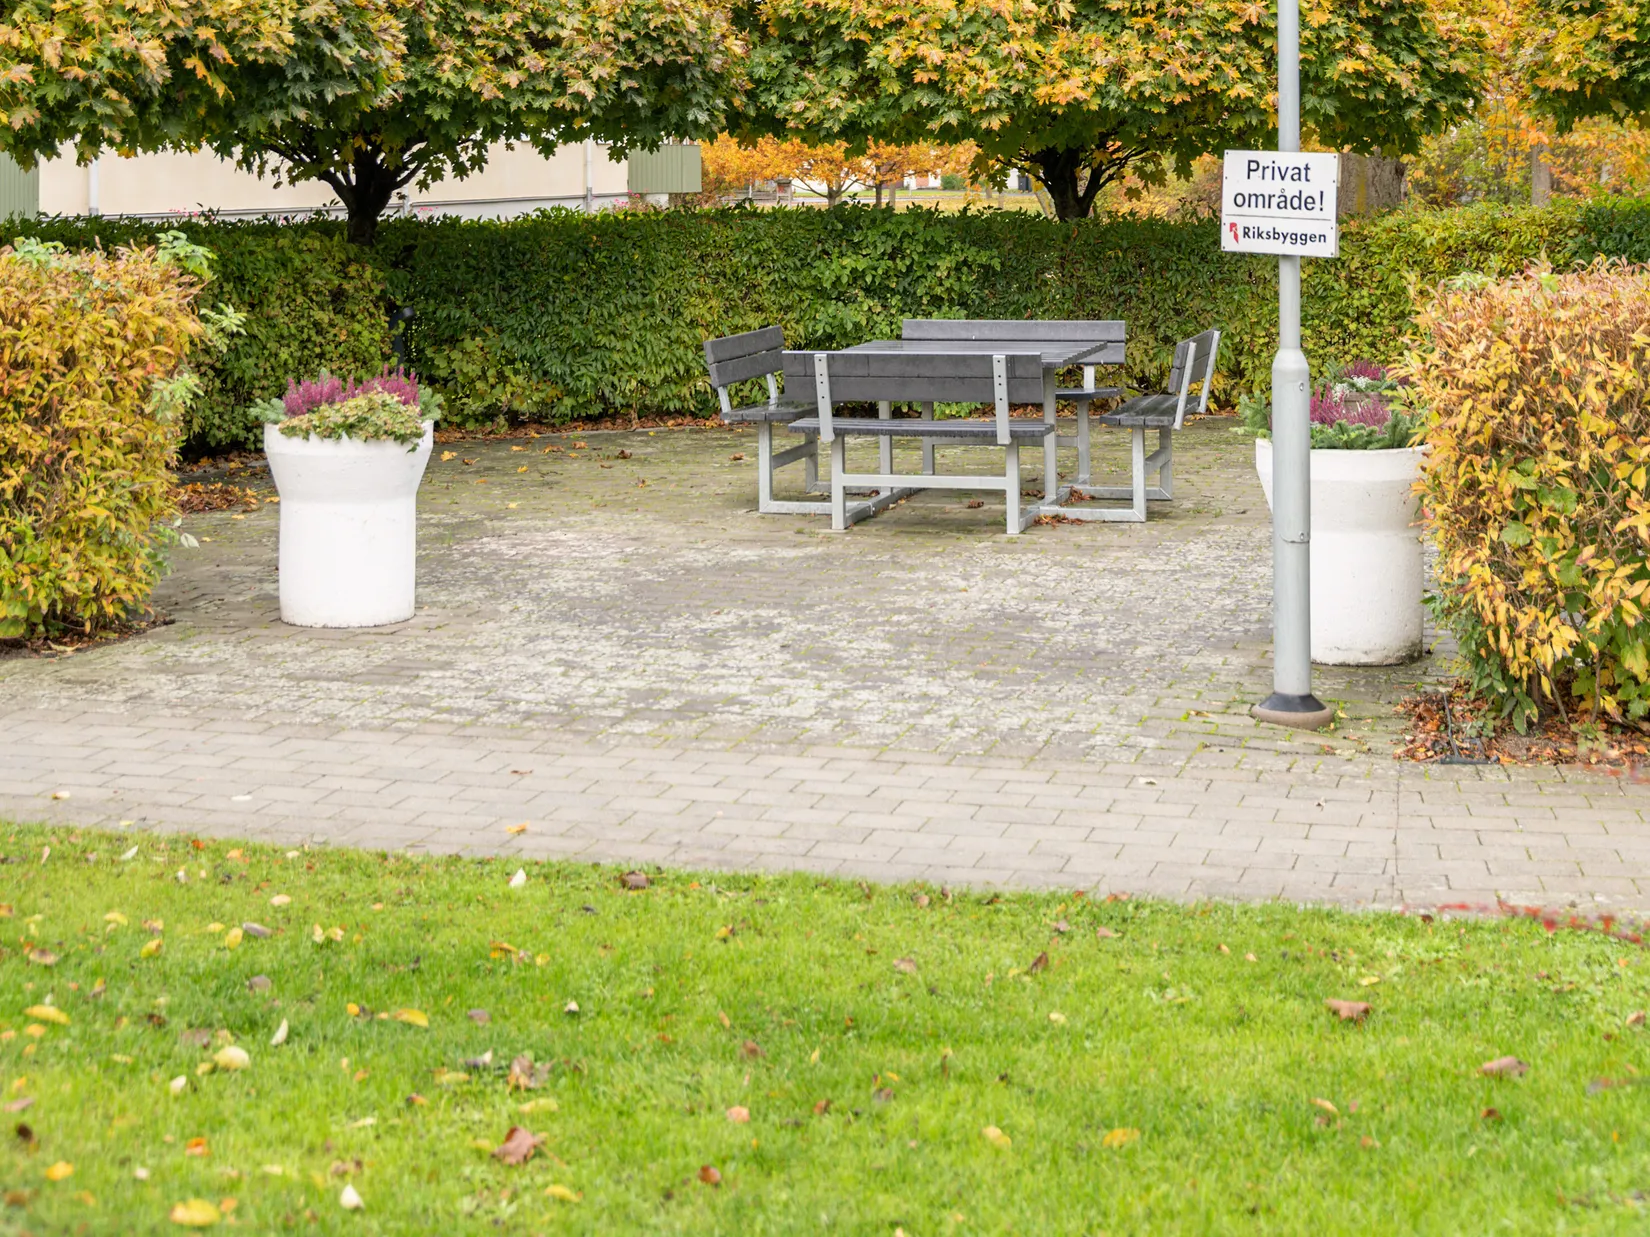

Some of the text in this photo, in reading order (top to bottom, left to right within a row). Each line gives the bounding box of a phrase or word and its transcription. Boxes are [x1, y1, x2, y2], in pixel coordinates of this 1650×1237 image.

[1247, 159, 1311, 182] Privat
[1233, 188, 1324, 212] område!
[1242, 226, 1327, 246] Riksbyggen
